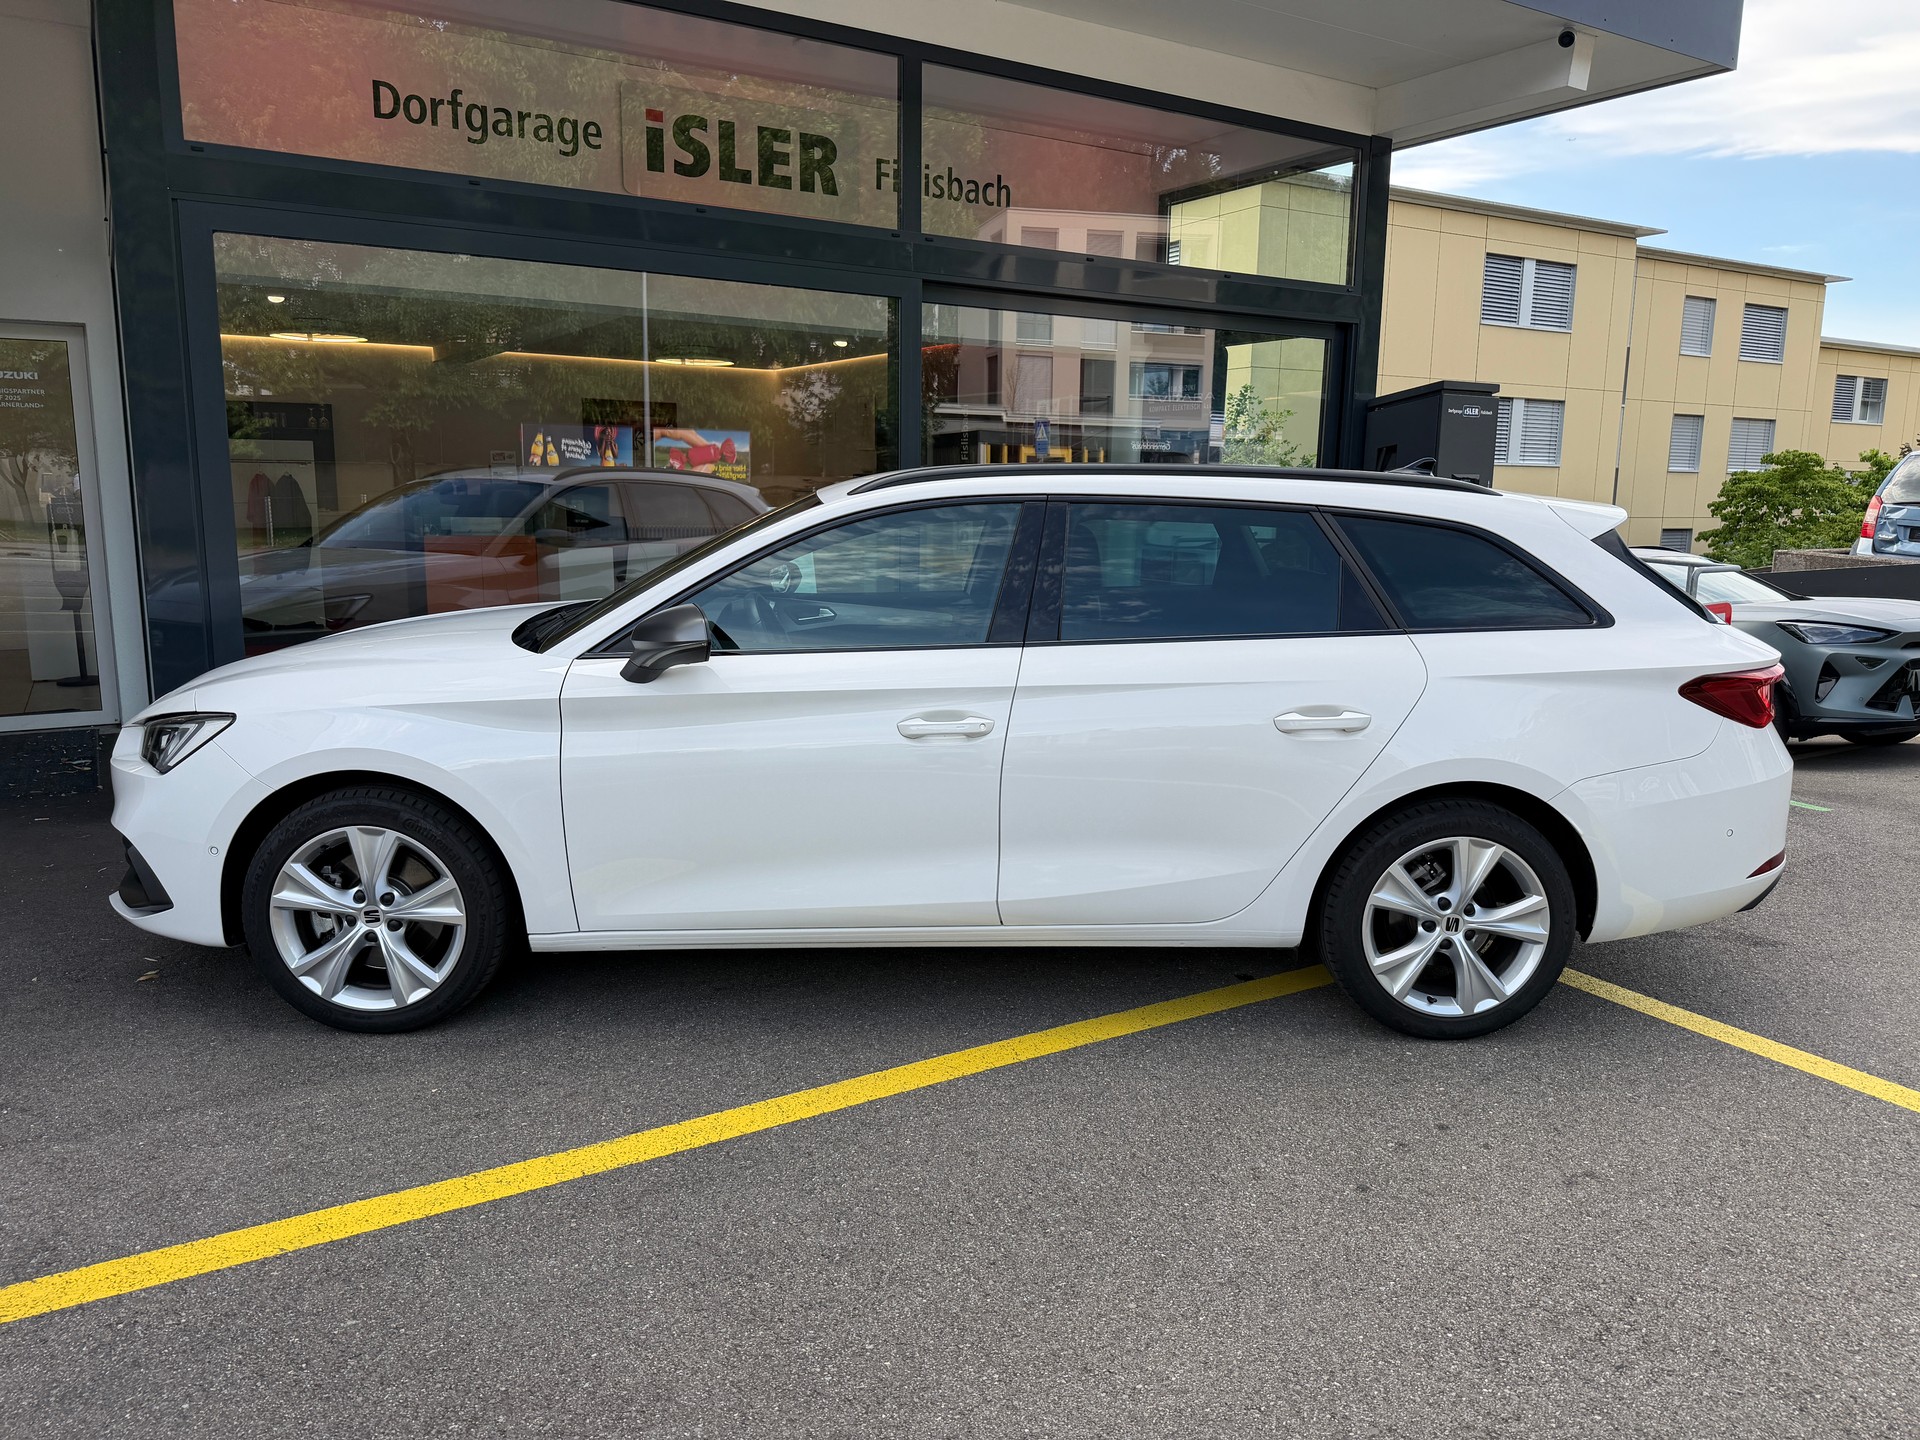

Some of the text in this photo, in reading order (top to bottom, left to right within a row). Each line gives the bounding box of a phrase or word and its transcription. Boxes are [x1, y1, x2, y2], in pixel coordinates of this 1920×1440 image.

[372, 79, 1011, 208] Dorfgarage iSLER Fiisbach
[402, 817, 462, 865] Continental
